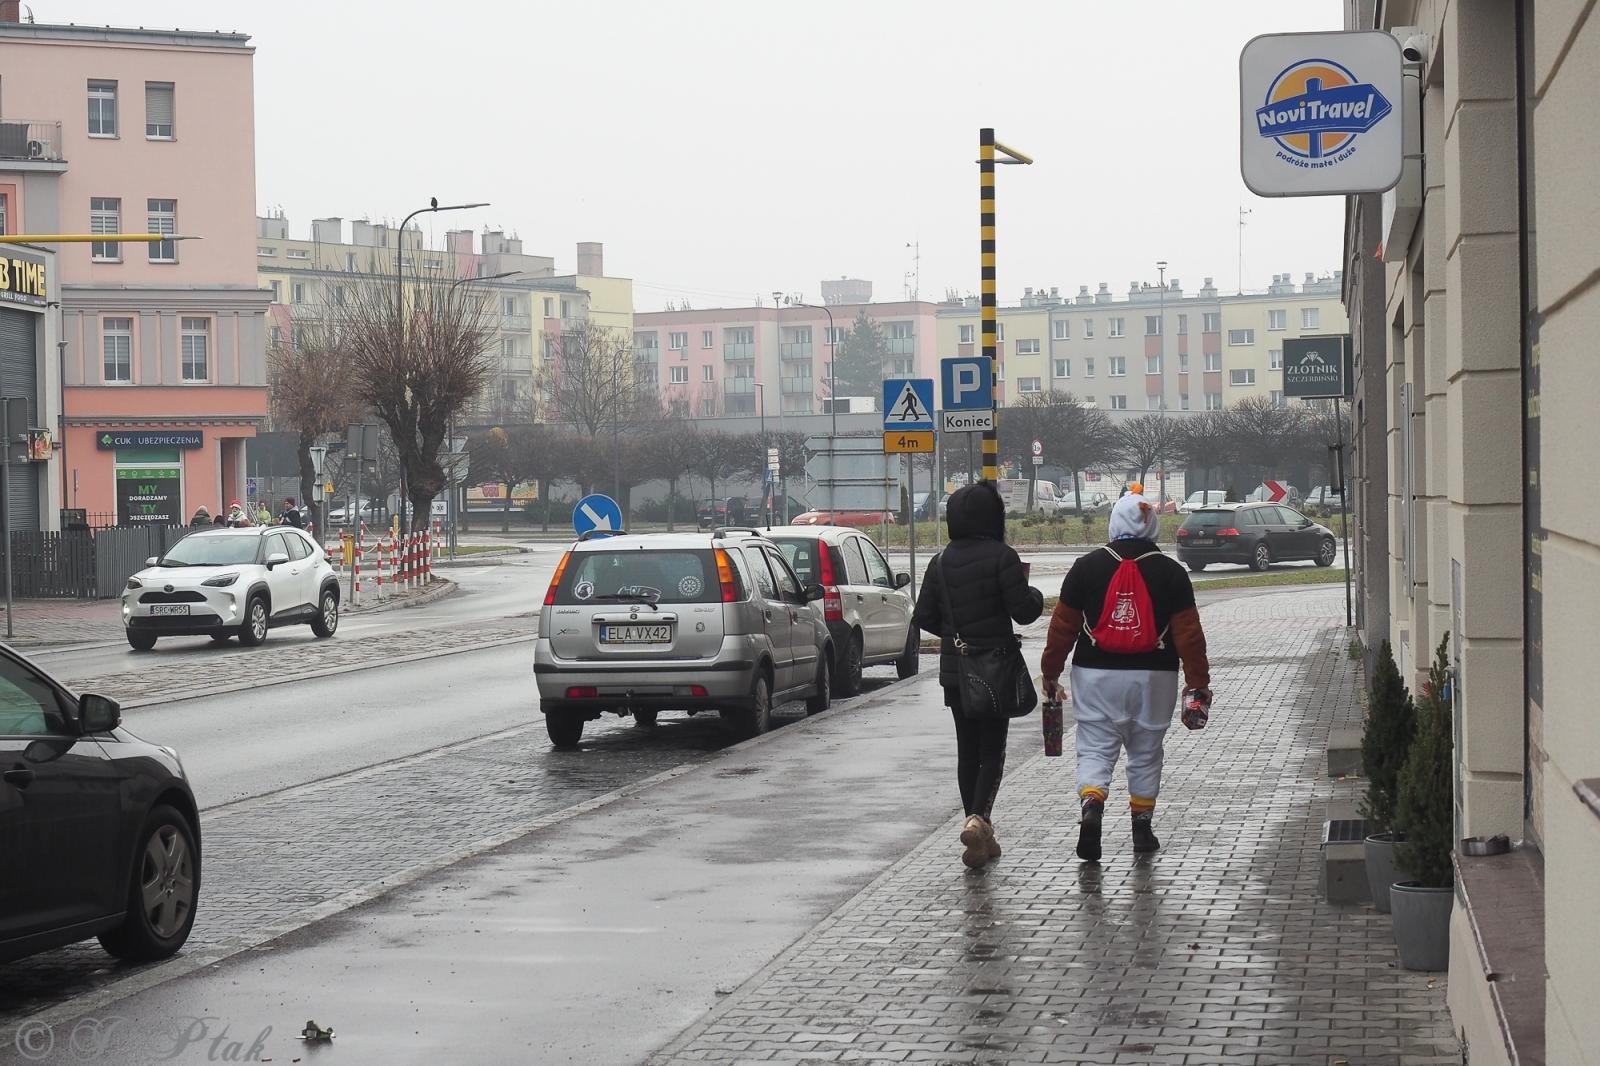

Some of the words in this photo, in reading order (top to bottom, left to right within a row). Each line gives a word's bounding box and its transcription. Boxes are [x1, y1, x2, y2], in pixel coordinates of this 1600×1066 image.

[1276, 150, 1309, 168] podróże
[1310, 160, 1333, 169] małe
[1338, 146, 1356, 162] duże
[12, 259, 46, 296] TIME
[1286, 364, 1338, 375] ZŁOTNIK
[952, 363, 981, 404] P
[946, 415, 991, 428] Koniec
[114, 437, 132, 445] CUK
[138, 436, 200, 445] UBEZPIECZENIA
[898, 436, 919, 448] 4m
[138, 485, 157, 495] MY
[140, 504, 157, 514] TY
[608, 627, 632, 640] ELA
[636, 627, 667, 640] VX42
